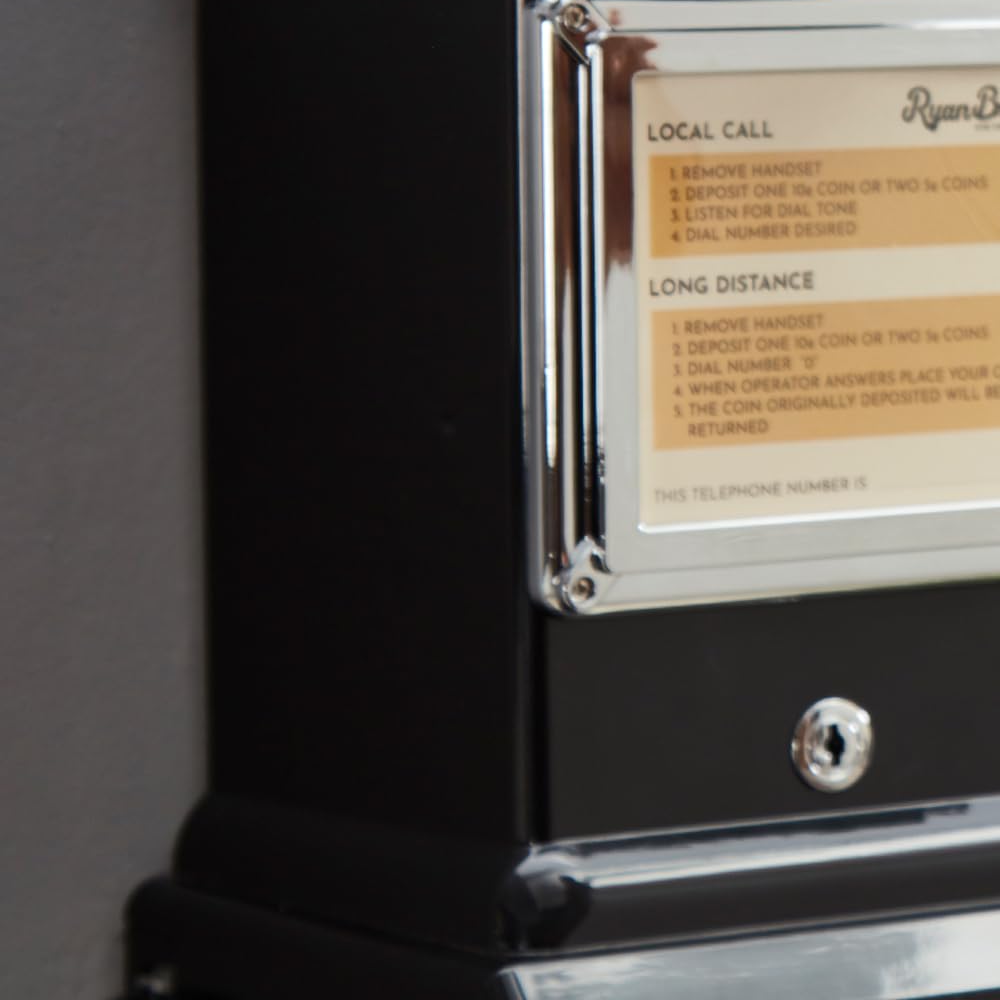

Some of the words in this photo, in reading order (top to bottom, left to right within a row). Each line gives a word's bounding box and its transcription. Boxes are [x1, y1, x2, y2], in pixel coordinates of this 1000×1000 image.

[901, 84, 970, 132] Ryan
[647, 122, 715, 143] LOCAL
[722, 120, 774, 140] CALL
[682, 164, 747, 180] REMOVE
[752, 161, 822, 177] HANDSET
[685, 184, 748, 202] DEPOSIT
[753, 183, 787, 199] ONE
[816, 180, 856, 196] COIN
[859, 179, 881, 195] OR
[886, 178, 919, 193] TWO
[941, 175, 989, 191] COINS
[685, 204, 737, 222] LISTEN
[742, 203, 772, 218] FOR
[777, 201, 811, 217] DIAL
[816, 200, 857, 216] TONE
[685, 227, 720, 242] DIAL
[725, 223, 790, 240] NUMBER
[794, 220, 857, 238] DESIRED
[648, 277, 709, 297] LONG
[716, 271, 816, 294] DISTANCE
[684, 317, 749, 335] REMOVE
[753, 313, 824, 331] HANDSET
[687, 337, 750, 356] DEPOSIT
[755, 336, 789, 352] ONE
[818, 333, 857, 349] COIN
[862, 331, 883, 347] OR
[888, 330, 921, 345] TWO
[943, 325, 990, 342] COINS
[687, 360, 722, 376] DIAL
[727, 356, 791, 373] NUMBER
[688, 380, 736, 396] WHEN
[741, 375, 820, 394] OPERATOR
[825, 370, 897, 388] ANSWERS
[900, 367, 944, 384] PLACE
[949, 365, 989, 381] YOUR
[688, 401, 718, 417] THE
[722, 399, 762, 415] COIN
[766, 394, 856, 413] ORIGINALLY
[860, 388, 940, 408] DEPOSITED
[945, 386, 980, 401] WILL
[687, 418, 769, 437] RETURNED
[654, 488, 687, 505] THIS
[692, 483, 781, 502] TELEPHONE
[786, 478, 850, 497] NUMBER
[854, 476, 868, 491] IS
